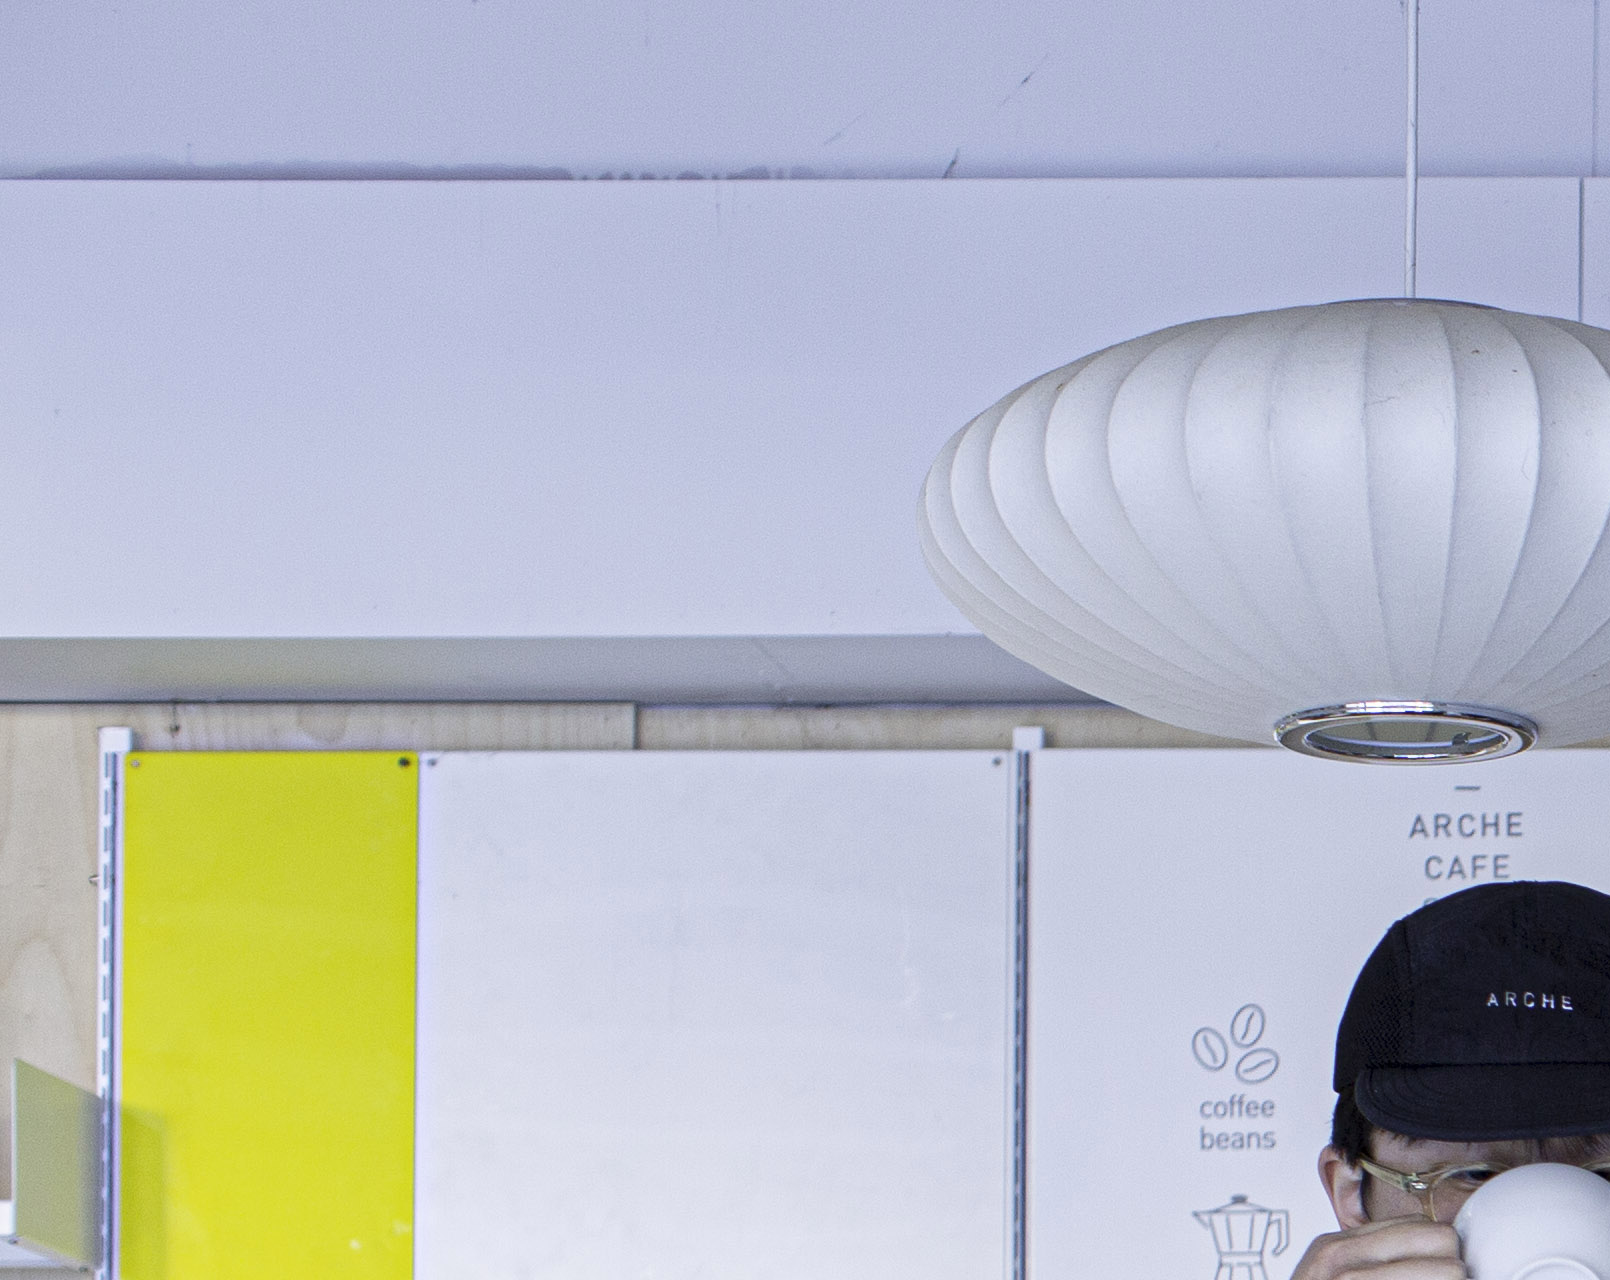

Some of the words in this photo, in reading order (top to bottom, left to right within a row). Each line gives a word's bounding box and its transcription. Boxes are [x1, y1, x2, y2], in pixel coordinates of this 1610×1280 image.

[1408, 811, 1524, 839] ARCHE
[1424, 853, 1510, 881] CAFE
[1486, 990, 1574, 1010] ARCHE
[1200, 1093, 1275, 1119] coffee
[1200, 1125, 1277, 1151] beans
